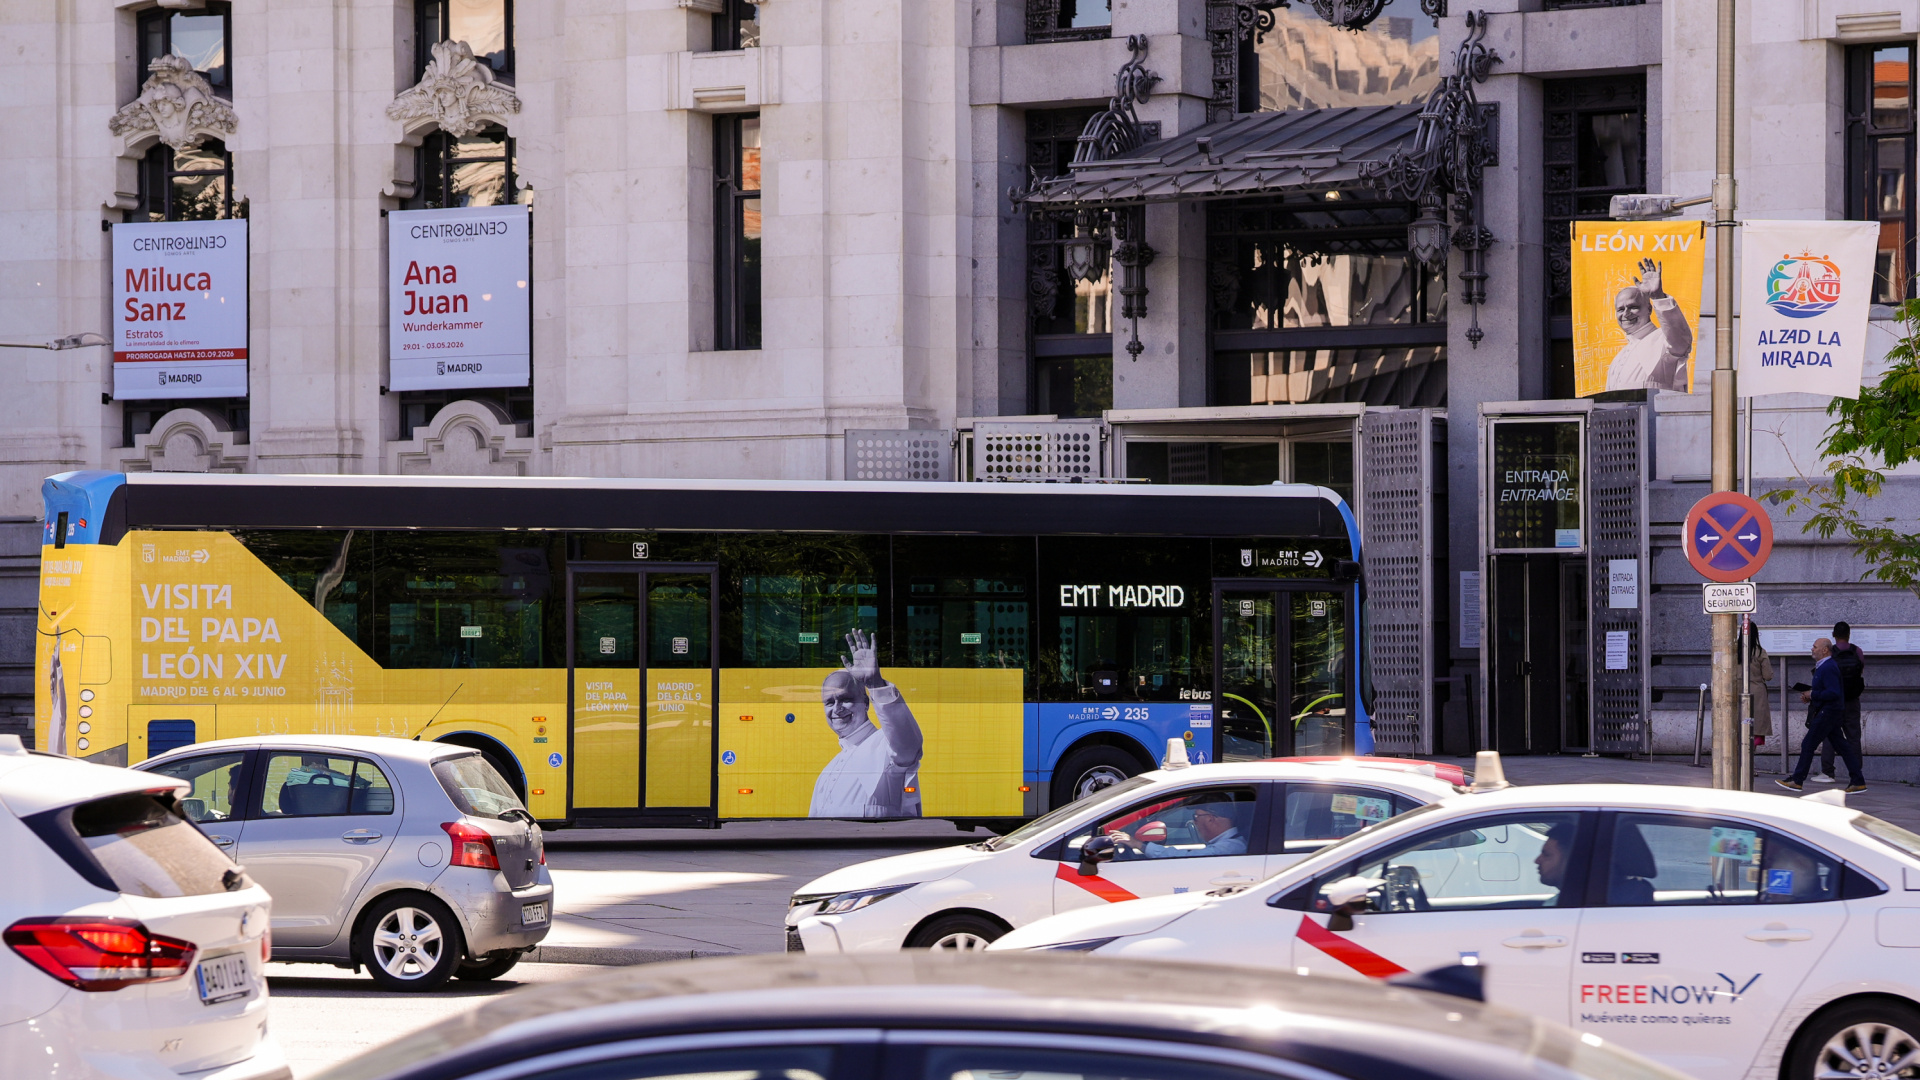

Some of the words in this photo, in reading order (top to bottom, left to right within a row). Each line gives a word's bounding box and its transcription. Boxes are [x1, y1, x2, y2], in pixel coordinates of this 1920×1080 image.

[1581, 229, 1645, 252] LEÓN
[1651, 234, 1694, 252] XIV
[403, 260, 457, 286] Ana
[125, 266, 211, 293] Miluca
[403, 290, 469, 316] Juan
[124, 297, 186, 322] Sanz
[403, 320, 484, 332] Wunderkammer
[125, 329, 164, 339] Estratos
[1757, 329, 1811, 346] ALZAD
[1817, 330, 1842, 347] LA
[126, 352, 173, 360] PRORROGADA
[196, 350, 235, 358] 20.09.2026
[1761, 351, 1833, 369] MIRADA
[447, 363, 483, 374] MADRID
[168, 373, 203, 384] MADRID
[1505, 470, 1569, 483] ENTRADA
[1500, 488, 1575, 501] ENTRANCE
[1279, 550, 1299, 558] EMT
[1261, 558, 1300, 566] MADRID
[1612, 573, 1634, 582] ENTRADA
[140, 583, 232, 609] VISITA
[1060, 584, 1101, 607] EMT
[1108, 584, 1185, 607] MADRID
[1611, 585, 1636, 595] ENTRANCE
[1711, 588, 1734, 597] ZONA
[1734, 588, 1745, 596] DE
[1707, 598, 1753, 608] SEGURIDAD
[140, 617, 190, 643] DEL
[201, 617, 282, 643] PAPA
[141, 646, 223, 679] LEÓN
[234, 653, 288, 679] XIV
[140, 686, 187, 698] MADRID
[190, 686, 209, 697] DEL
[212, 686, 220, 697] 6
[223, 686, 238, 697] AL
[241, 686, 249, 697] 9
[252, 686, 286, 697] JUNIO
[585, 681, 613, 691] VISITA
[657, 682, 695, 692] MADRID
[585, 692, 600, 701] DEL
[603, 692, 628, 701] PAPA
[657, 692, 672, 701] DEL
[674, 692, 681, 701] 6
[682, 692, 694, 701] AL
[695, 692, 702, 701] 9
[585, 701, 610, 712] LEÓN
[612, 703, 629, 712] XIV
[657, 703, 685, 712] JUNIO
[1124, 707, 1149, 720] 235
[1580, 1011, 1638, 1024] Muévete
[1640, 1015, 1679, 1024] como
[1682, 1012, 1732, 1026] quieras
